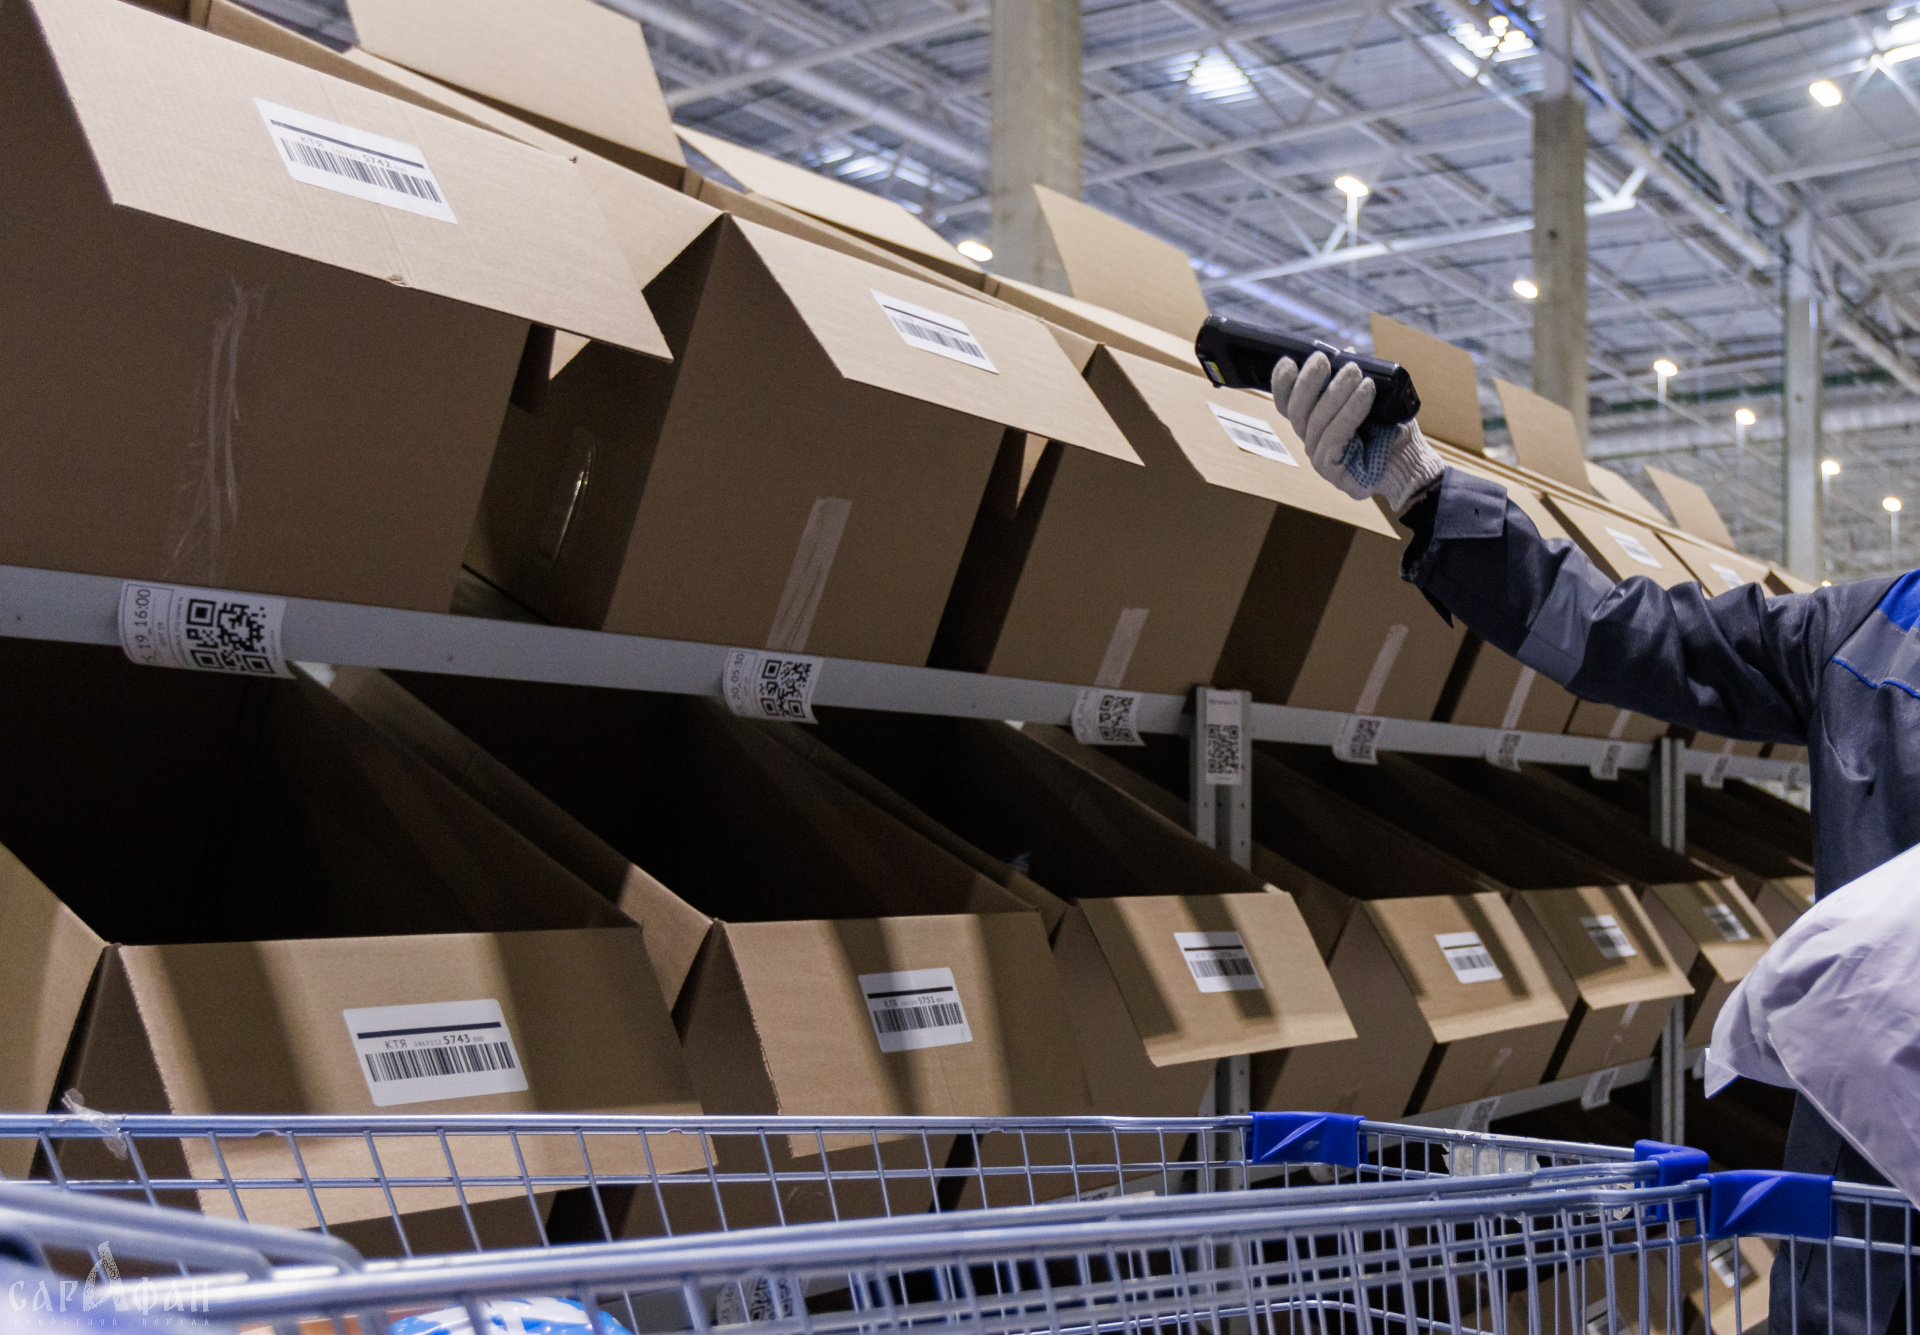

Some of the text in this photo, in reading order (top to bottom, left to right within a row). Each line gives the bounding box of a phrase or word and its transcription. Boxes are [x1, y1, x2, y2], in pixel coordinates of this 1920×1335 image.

[362, 153, 391, 169] 5742
[384, 1038, 407, 1050] КТЯ
[443, 1033, 471, 1045] 5743
